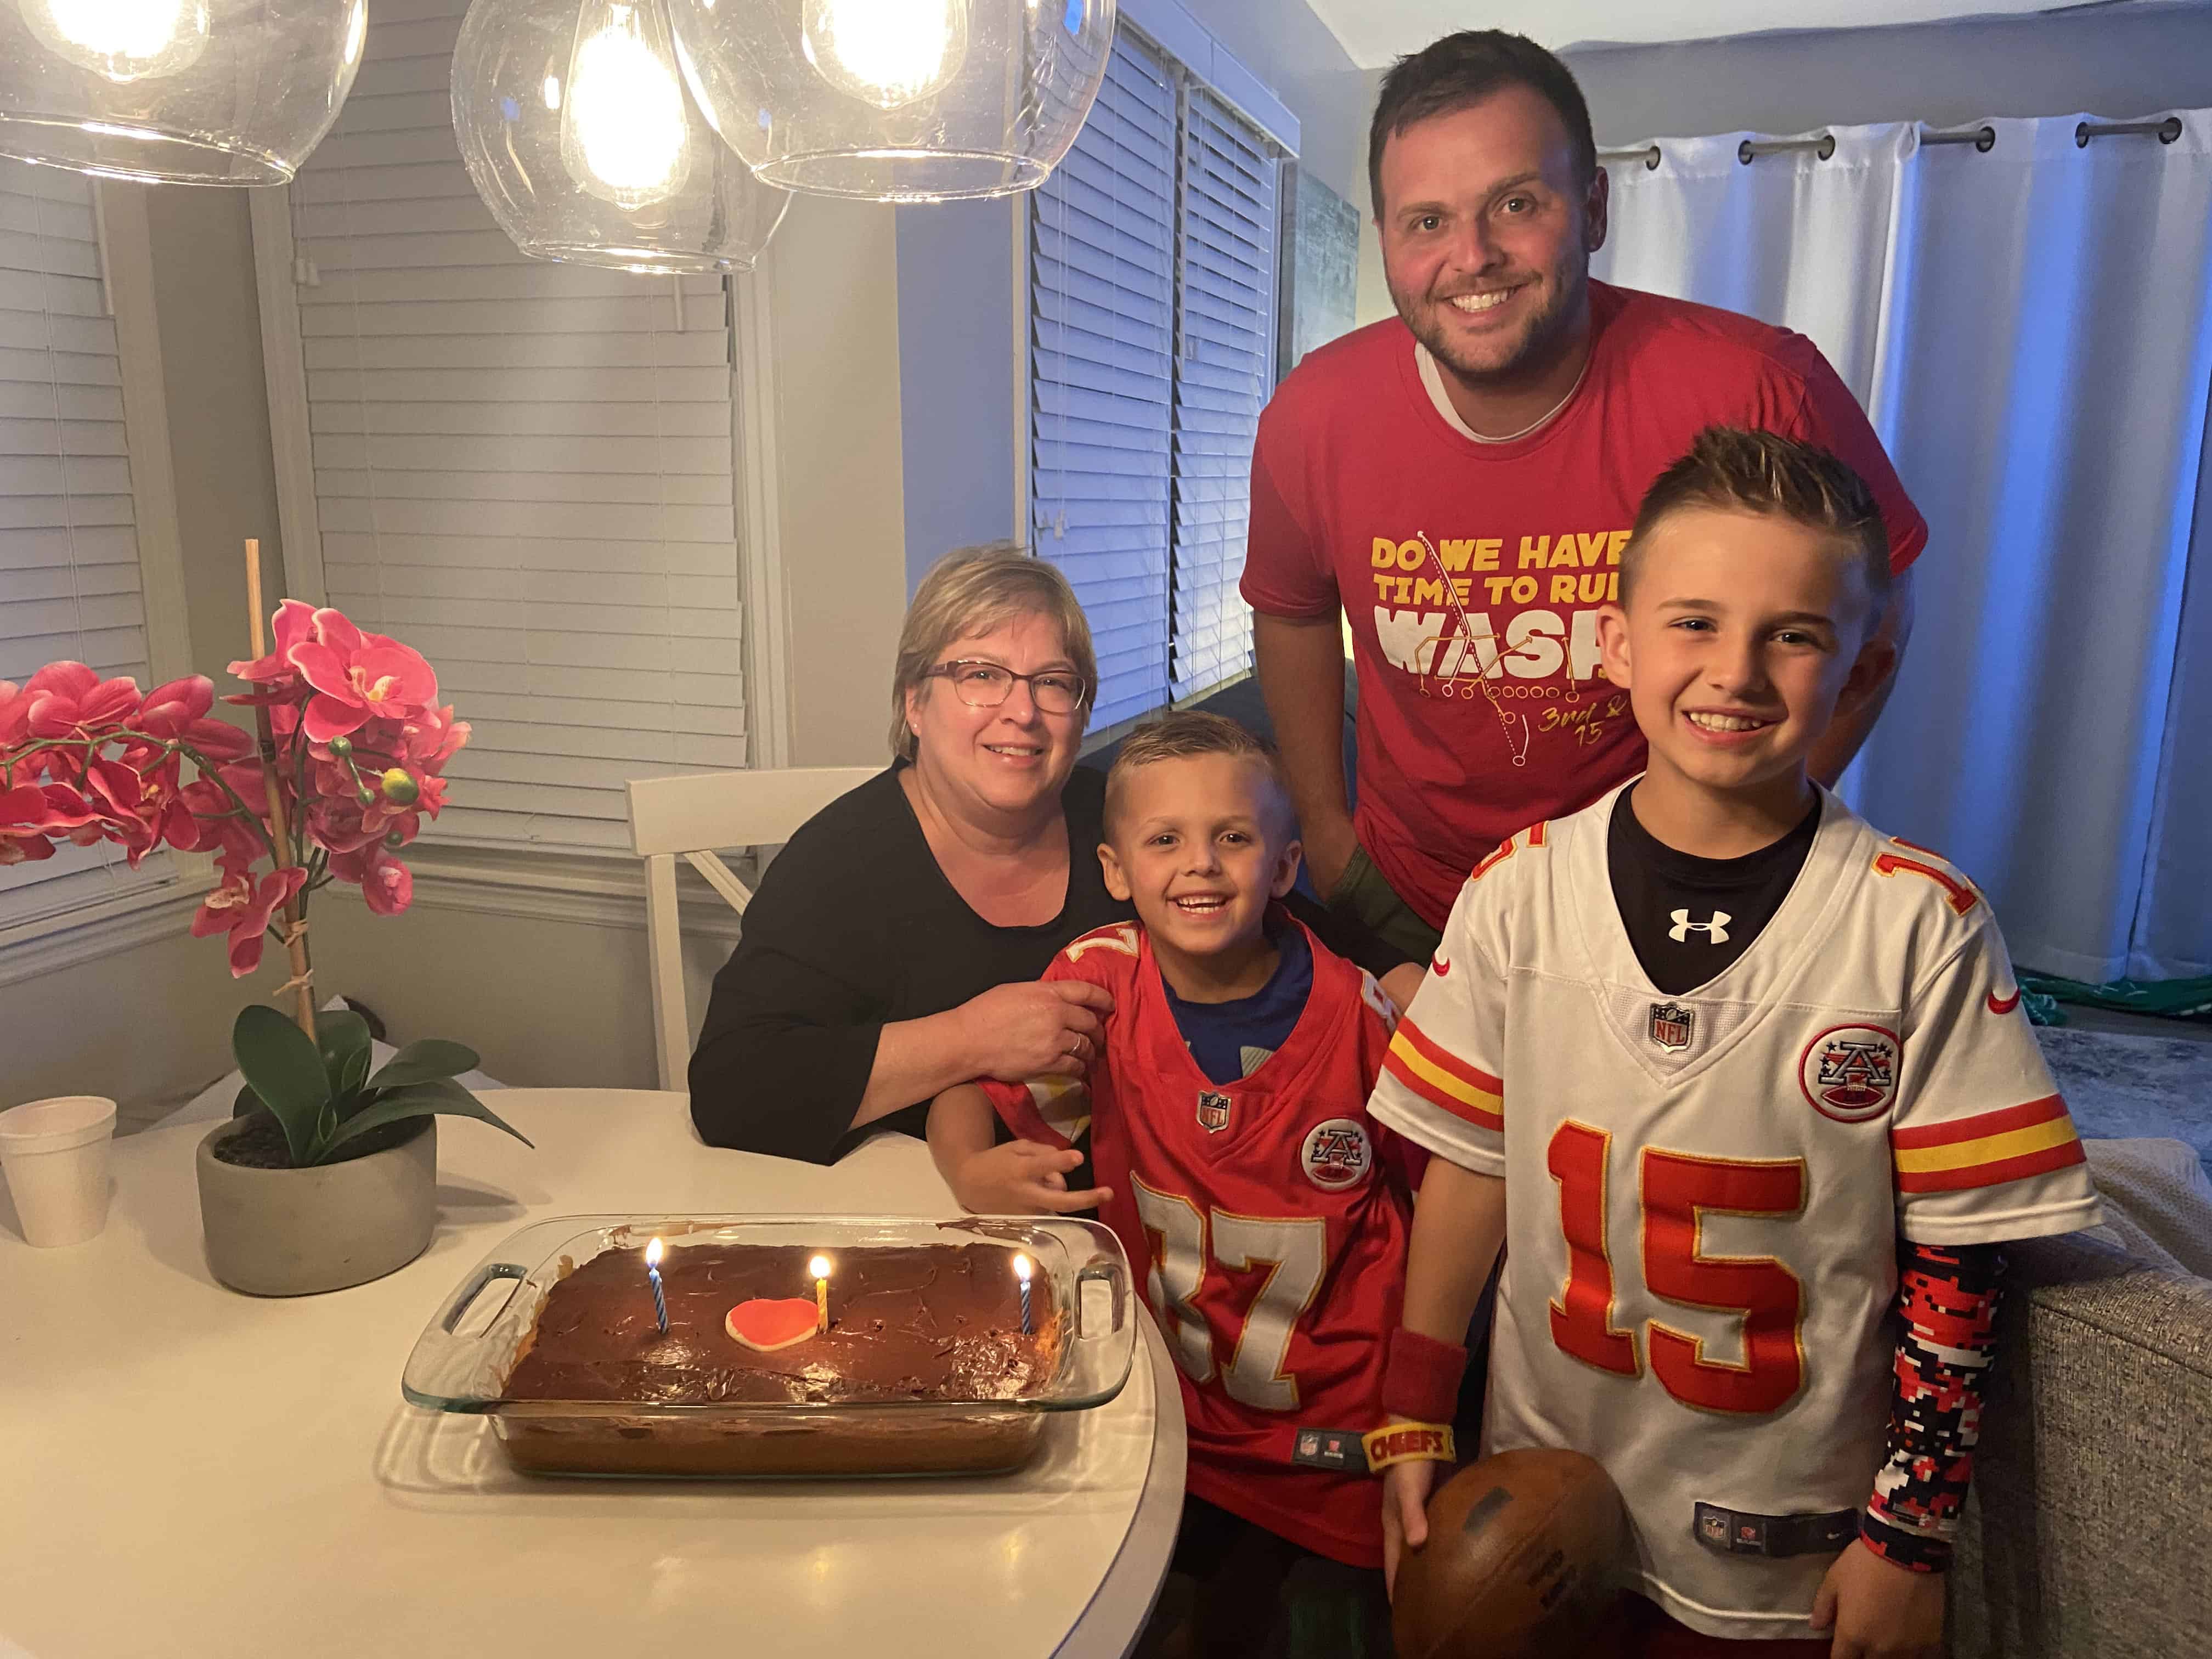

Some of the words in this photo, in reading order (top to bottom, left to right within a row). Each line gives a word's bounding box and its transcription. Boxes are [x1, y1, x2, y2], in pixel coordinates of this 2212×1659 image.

[1372, 537, 1426, 571] DO
[1440, 539, 1503, 572] WE
[1373, 573, 1472, 606] TIME
[1484, 575, 1538, 606] TO
[1656, 1020, 1686, 1043] NFL
[1201, 1107, 1224, 1126] NFL
[1547, 1118, 1809, 1415] 15
[1370, 1430, 1443, 1463] CHIEFS
